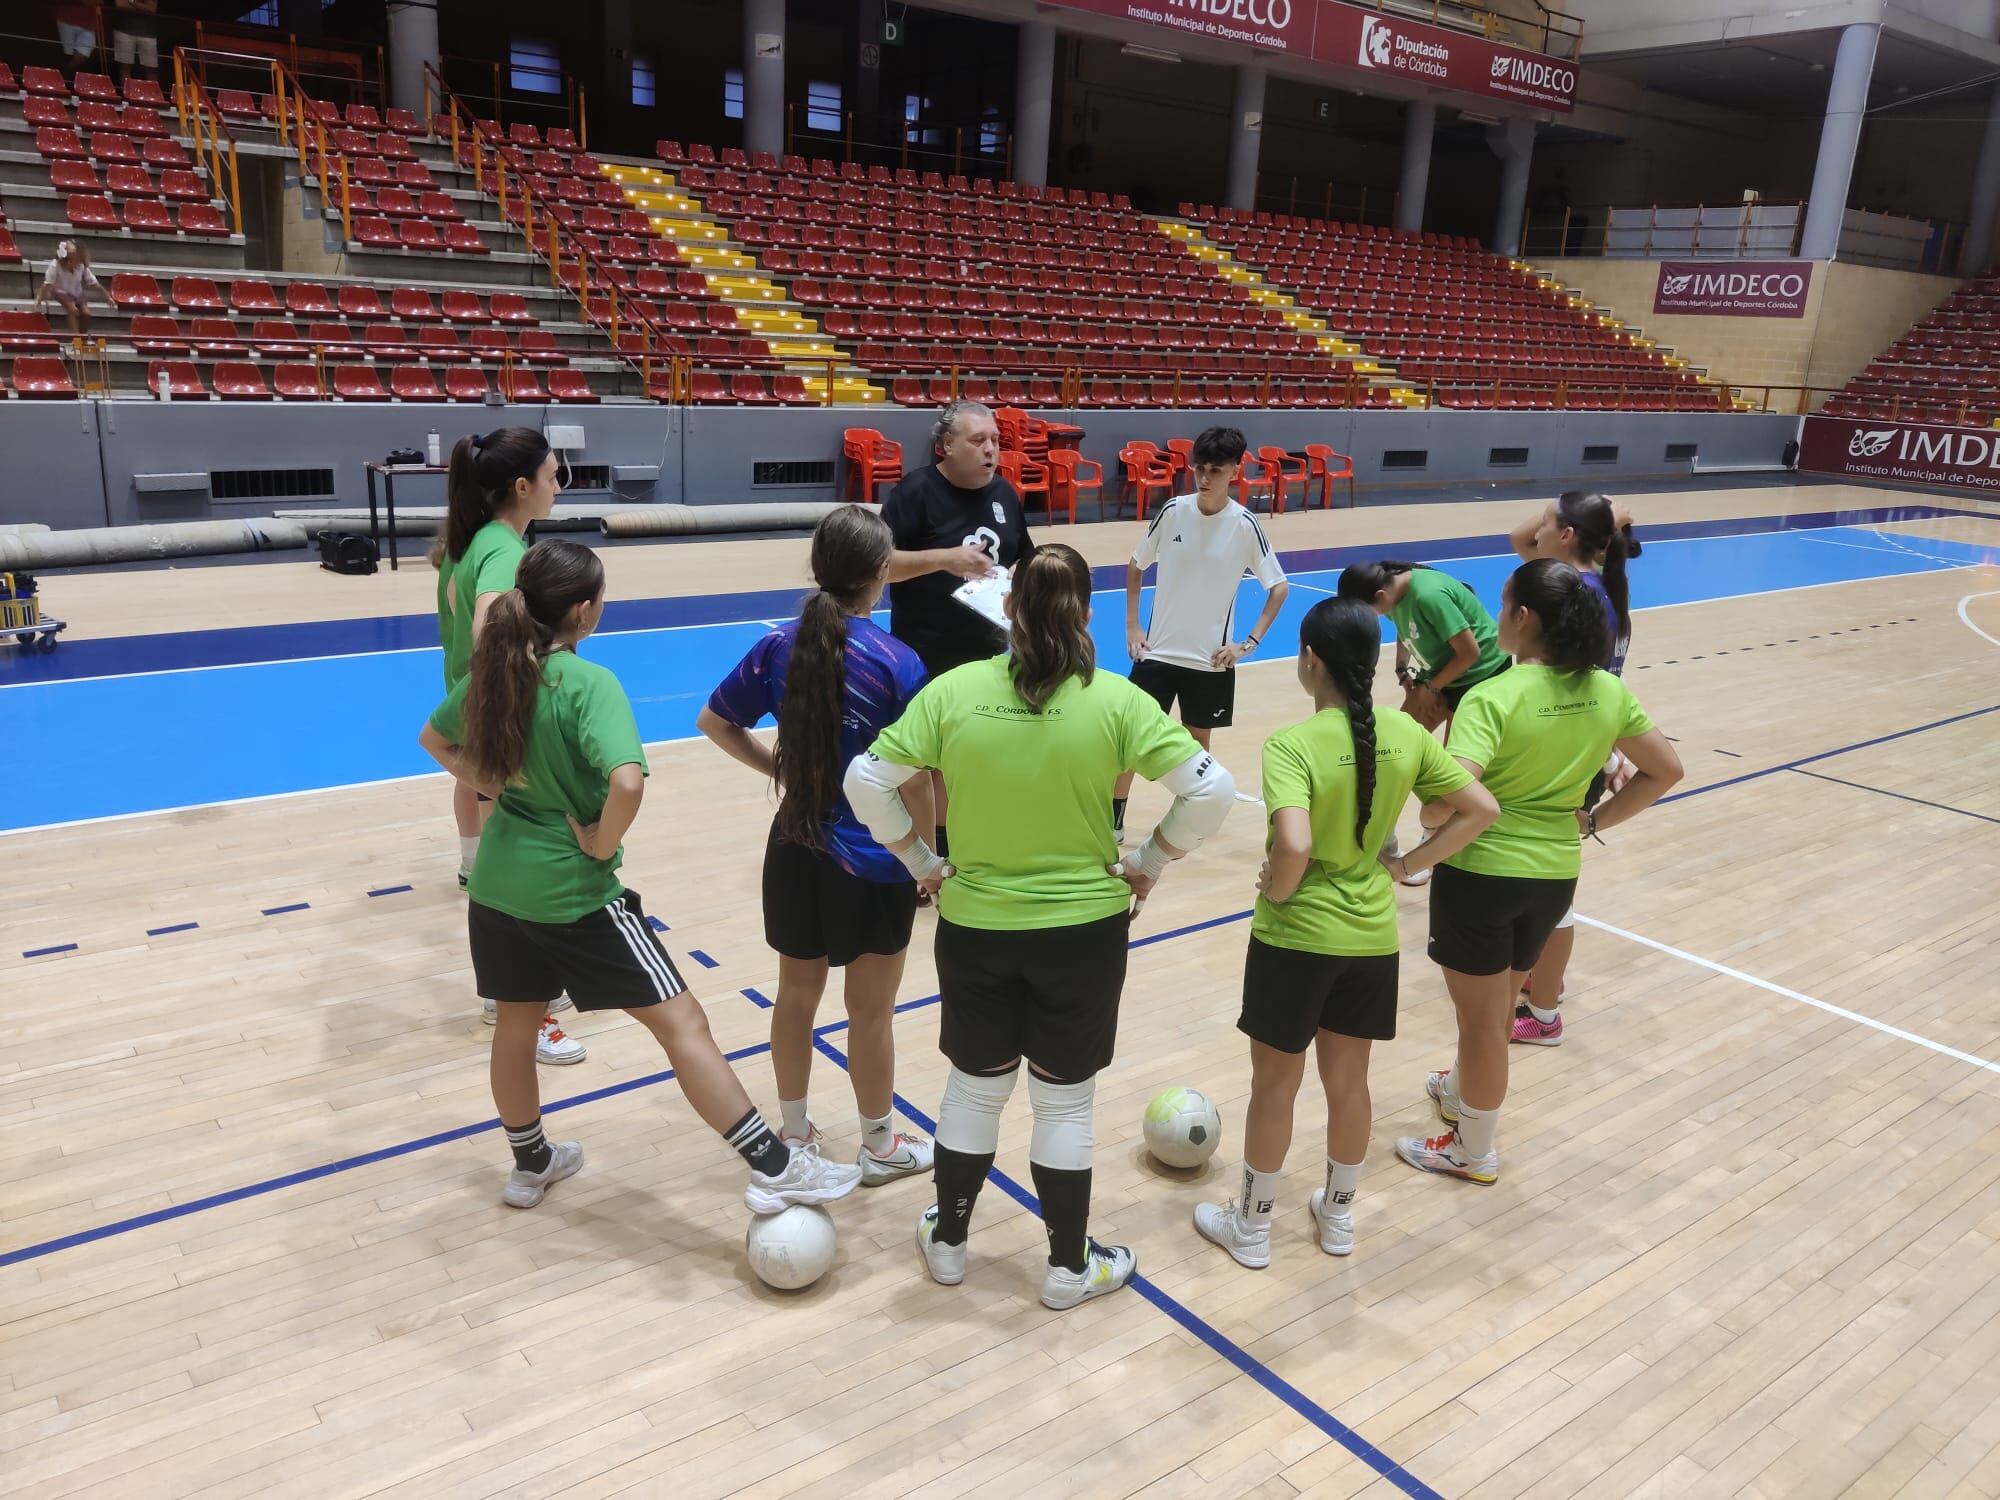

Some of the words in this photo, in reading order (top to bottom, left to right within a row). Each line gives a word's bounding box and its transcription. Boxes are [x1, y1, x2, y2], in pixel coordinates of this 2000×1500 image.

[885, 22, 897, 41] D
[1127, 5, 1163, 23] Instituto
[1164, 13, 1204, 31] Municipal
[1205, 23, 1217, 34] de
[1218, 25, 1254, 43] Deportes
[1254, 32, 1287, 49] Córdoba
[1395, 34, 1449, 61] Diputación
[1393, 55, 1407, 70] de
[1408, 56, 1448, 78] Córdoba
[1511, 58, 1575, 94] IMDECO
[1320, 102, 1329, 117] E
[1693, 273, 1804, 297] IMDECO
[1688, 299, 1721, 309] Municipal
[1733, 301, 1766, 309] Deportes
[1767, 301, 1798, 309] Córdoba
[1845, 462, 1889, 475] Instituto
[1890, 467, 1946, 481] Municipal
[1948, 473, 1964, 483] de
